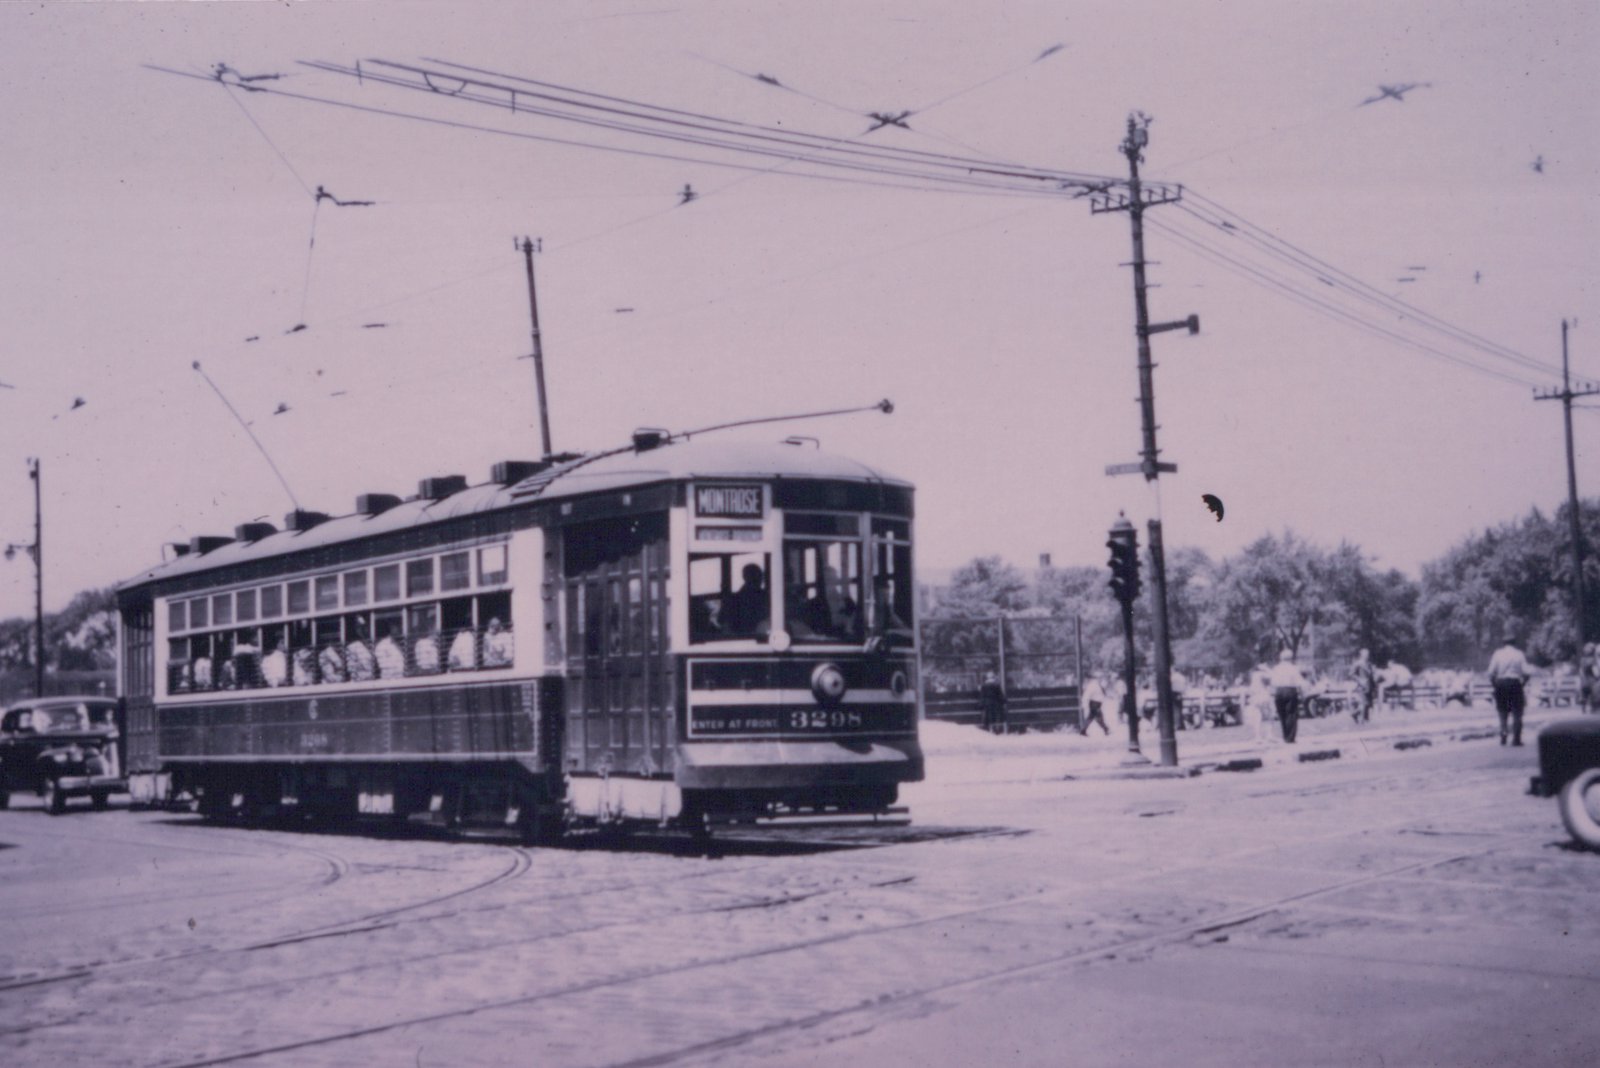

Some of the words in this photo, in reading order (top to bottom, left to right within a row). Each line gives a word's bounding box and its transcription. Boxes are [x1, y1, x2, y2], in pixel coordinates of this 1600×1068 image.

[698, 488, 761, 513] MONTROSE
[692, 719, 724, 729] ENTER
[728, 719, 742, 729] AT
[745, 718, 778, 729] FRONT
[790, 710, 862, 729] 3298
